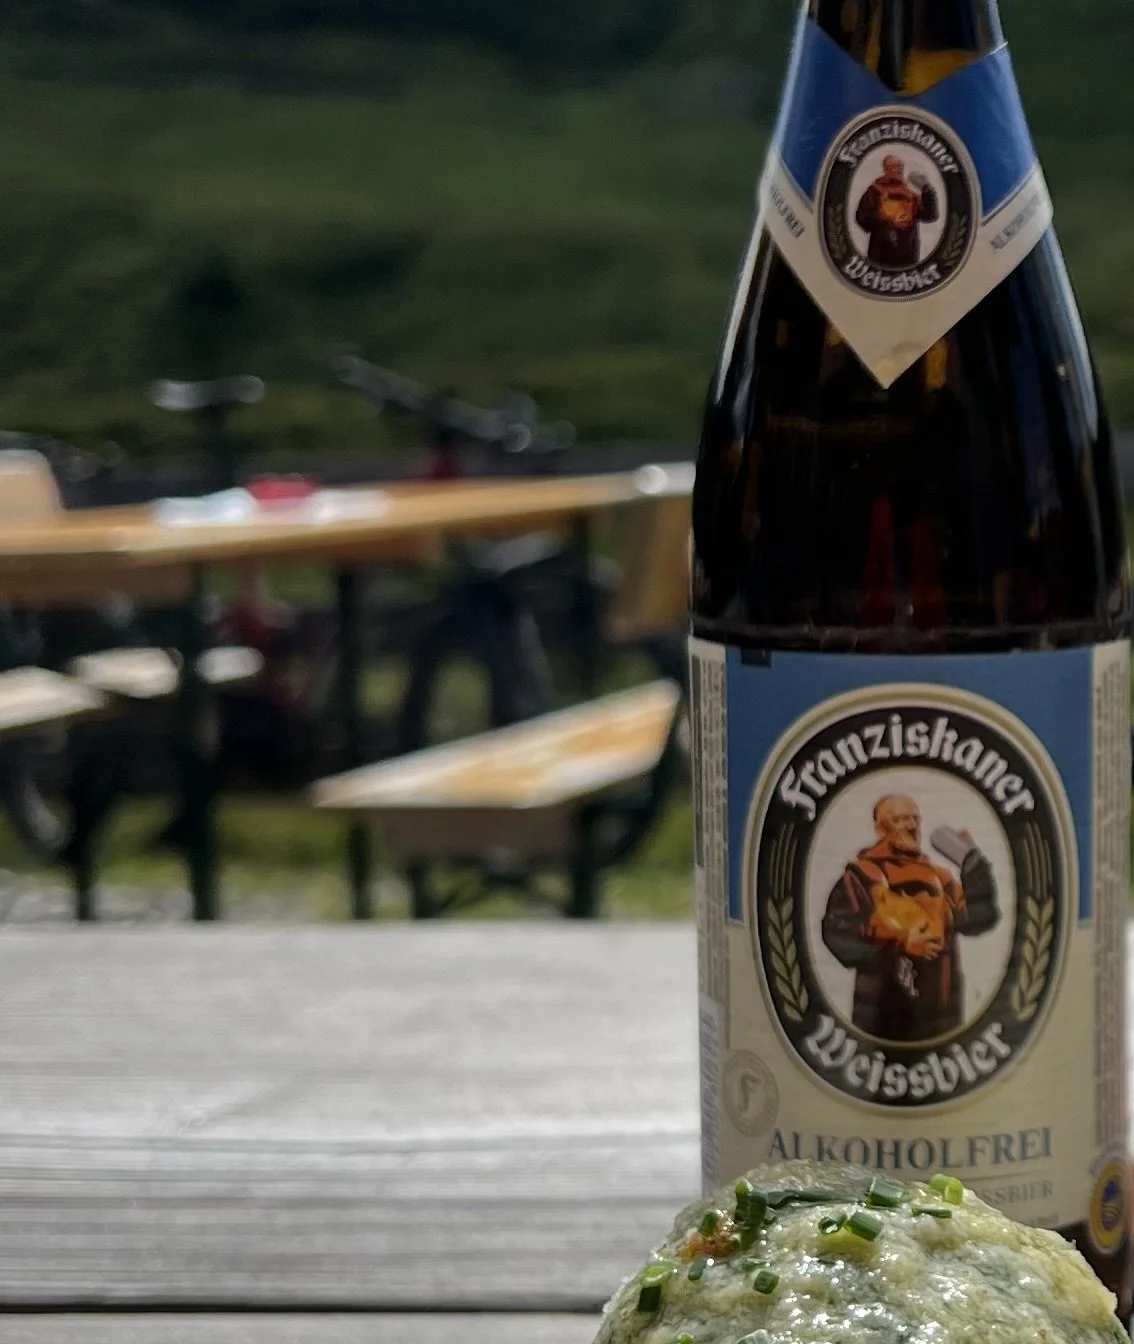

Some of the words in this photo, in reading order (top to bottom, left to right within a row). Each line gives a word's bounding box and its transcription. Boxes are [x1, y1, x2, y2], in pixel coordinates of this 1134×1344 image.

[839, 120, 959, 173] Franziskaner
[845, 257, 941, 292] Weissbier
[779, 715, 1035, 822] Franziskaner
[805, 1015, 1012, 1099] Weissbier
[769, 1127, 1054, 1170] ALKOHOLFREI
